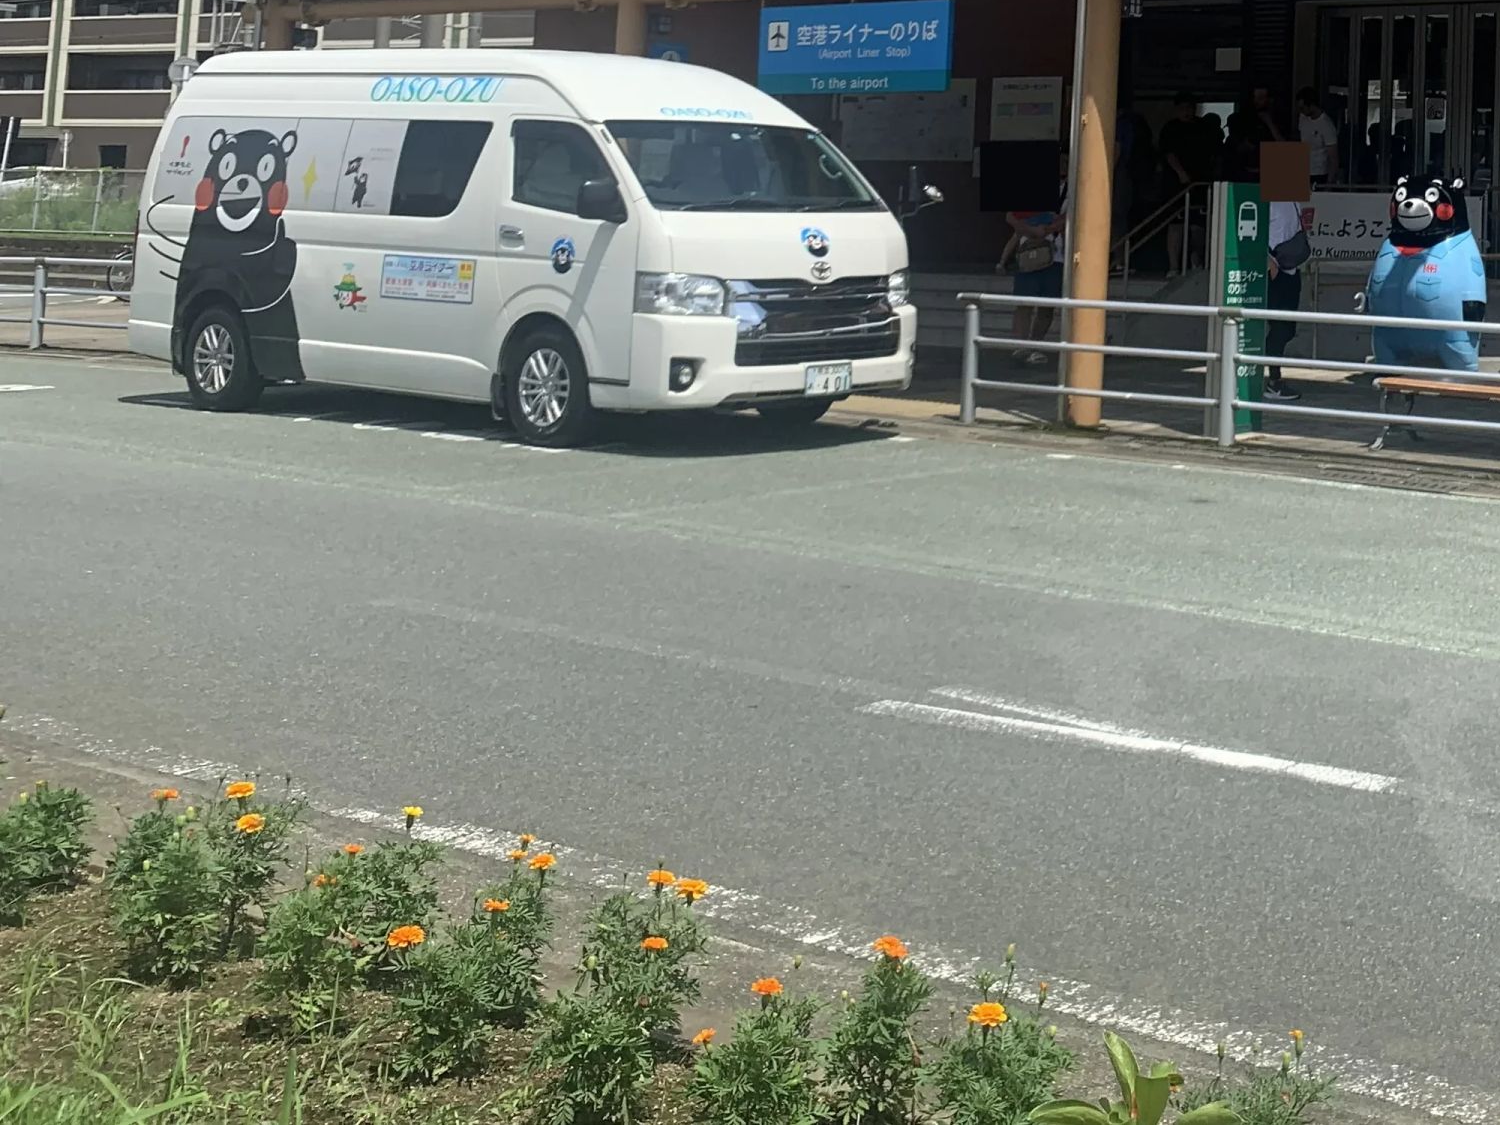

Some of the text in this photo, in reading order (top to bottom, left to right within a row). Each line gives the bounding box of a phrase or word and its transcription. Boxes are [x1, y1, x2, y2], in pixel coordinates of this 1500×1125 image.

[796, 19, 940, 46] 空港ライナーのりば
[818, 46, 912, 60] (Airport Liner Stop)
[370, 75, 505, 103] OASO-OZU
[810, 77, 889, 91] To the airport
[1311, 247, 1323, 257] to
[1227, 283, 1248, 295] のりば
